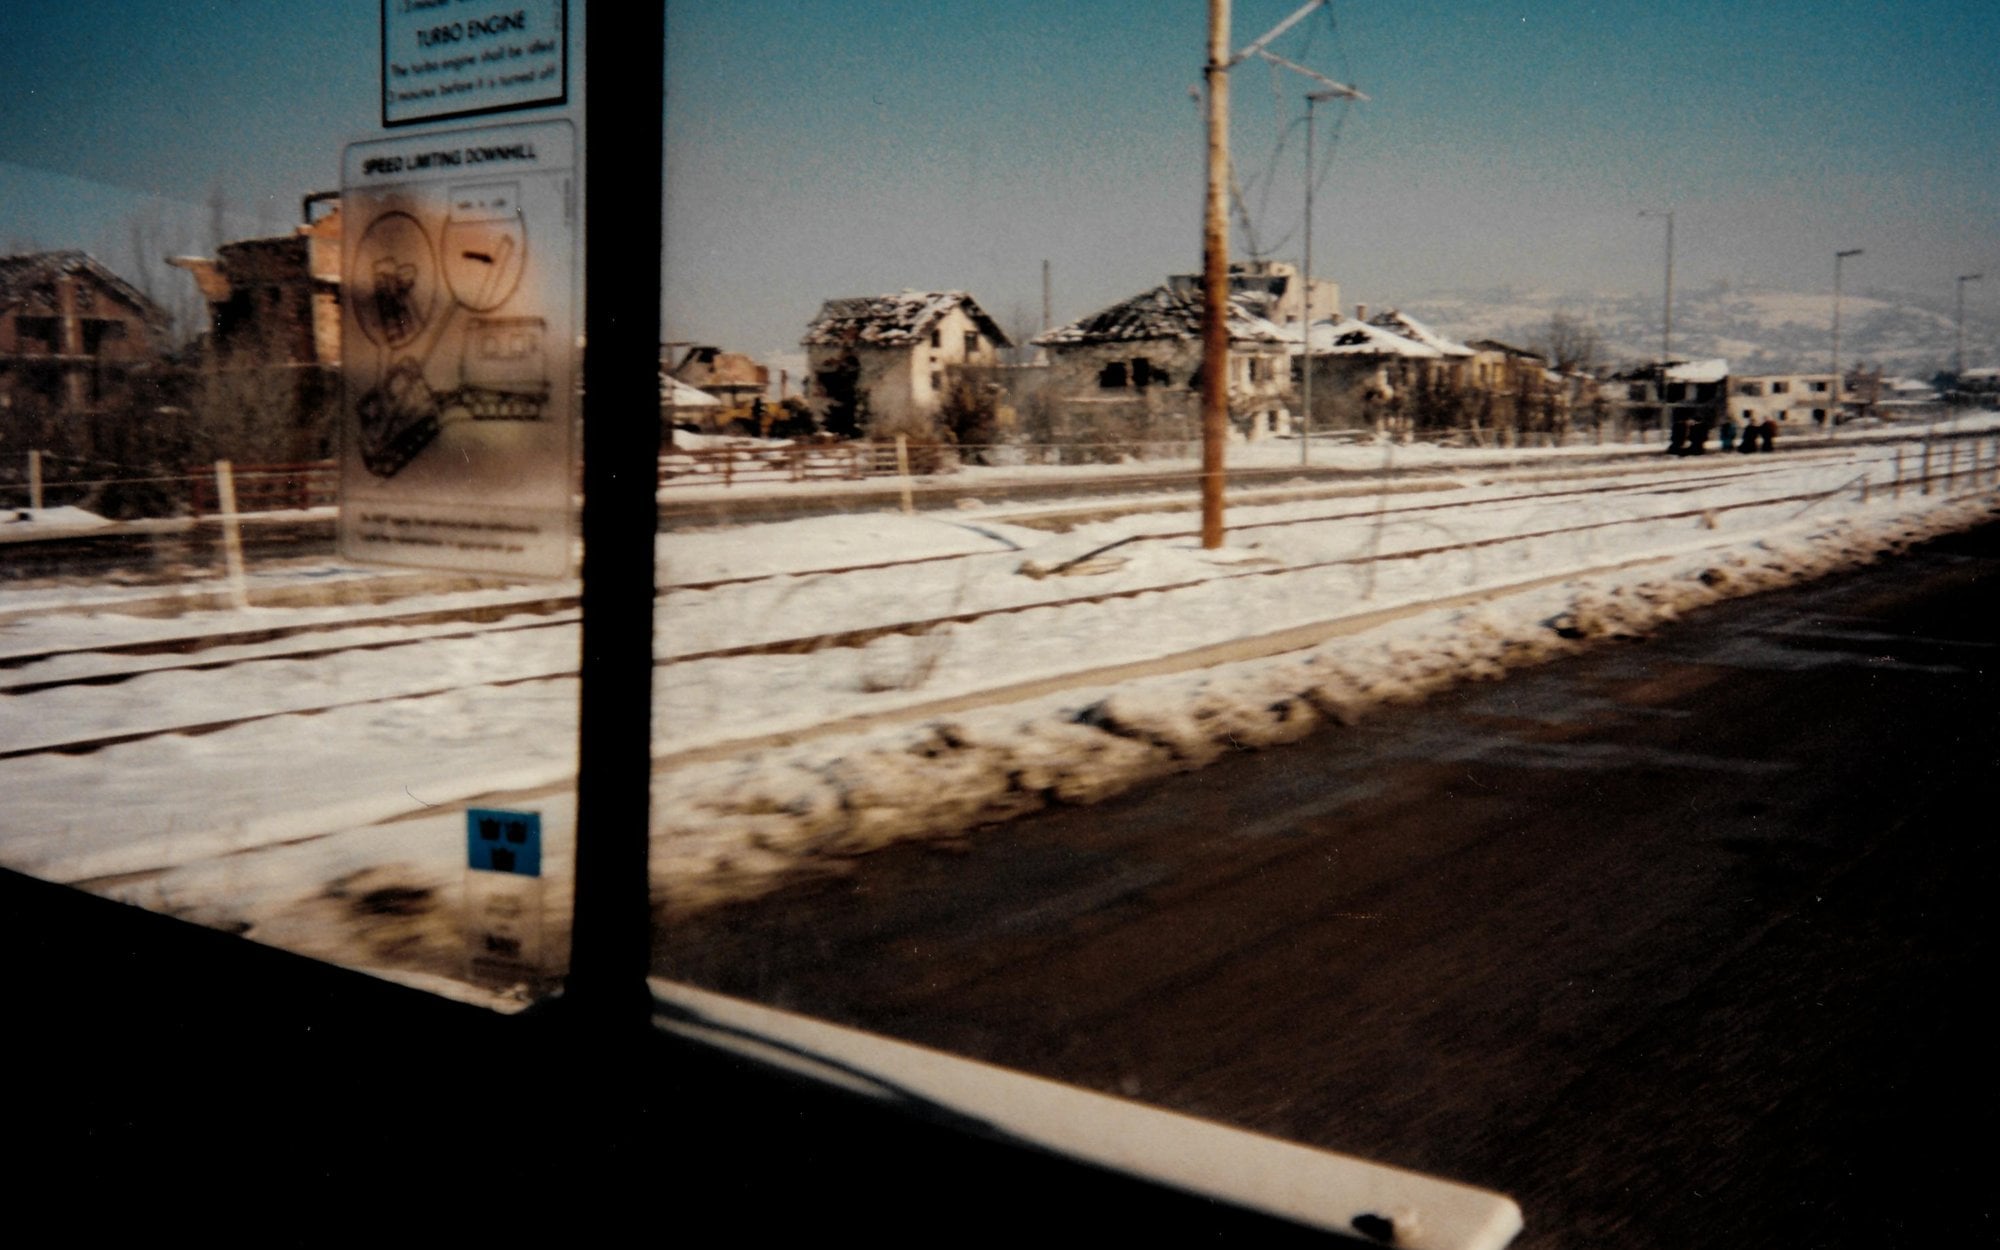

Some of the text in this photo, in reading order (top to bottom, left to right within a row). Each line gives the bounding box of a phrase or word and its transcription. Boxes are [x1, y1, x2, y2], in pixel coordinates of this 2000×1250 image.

[417, 23, 462, 47] TURBO
[467, 9, 526, 40] ENGINE
[362, 141, 537, 176] SPEED LIMITING DOWNHILL
